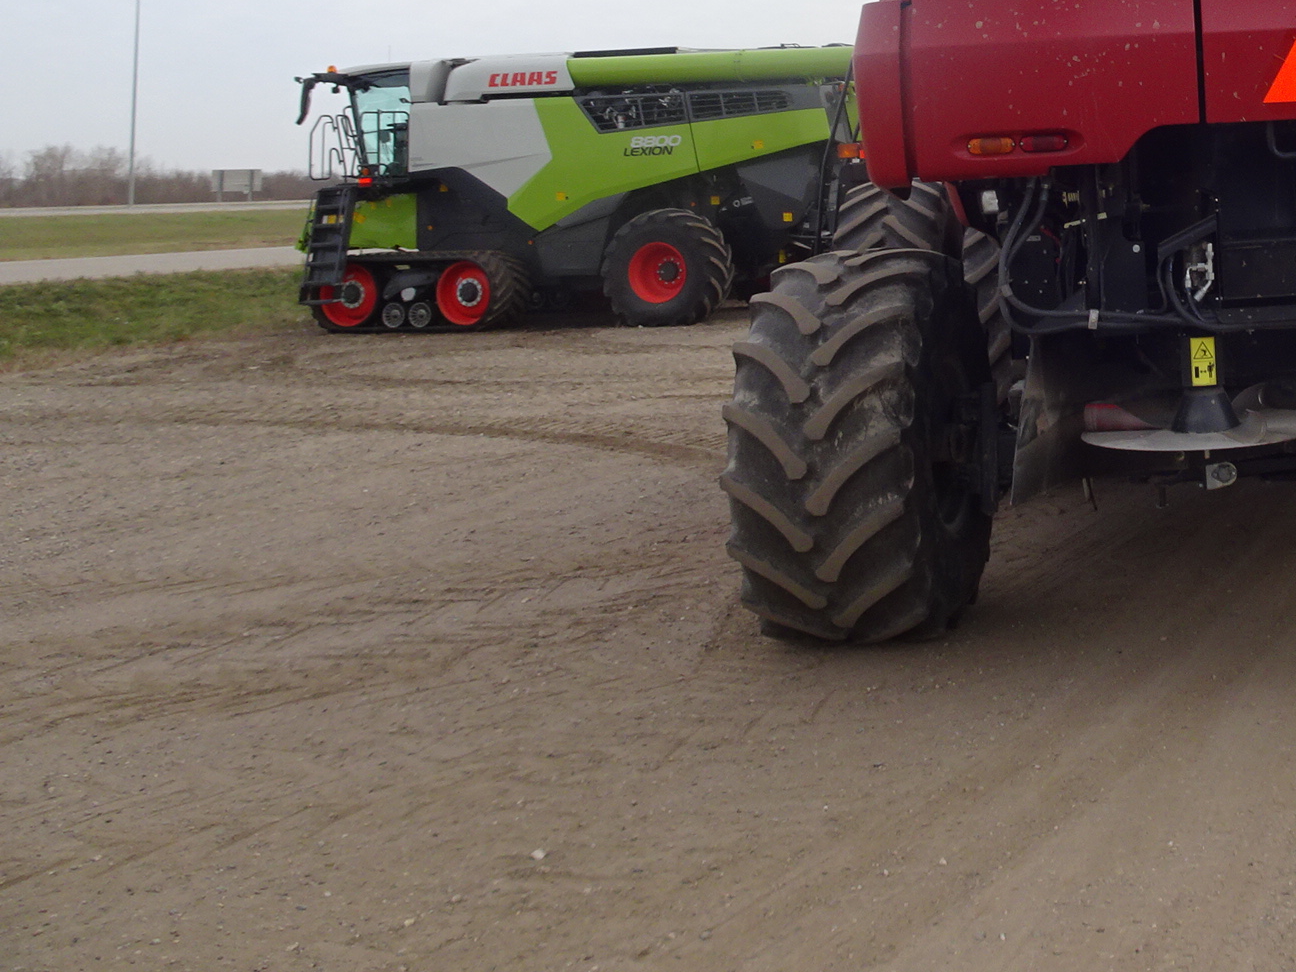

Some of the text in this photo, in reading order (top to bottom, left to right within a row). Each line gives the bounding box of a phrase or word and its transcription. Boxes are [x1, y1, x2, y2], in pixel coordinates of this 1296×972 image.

[488, 71, 558, 87] CLAAS
[630, 134, 682, 148] 8800
[624, 145, 674, 157] LEXION
